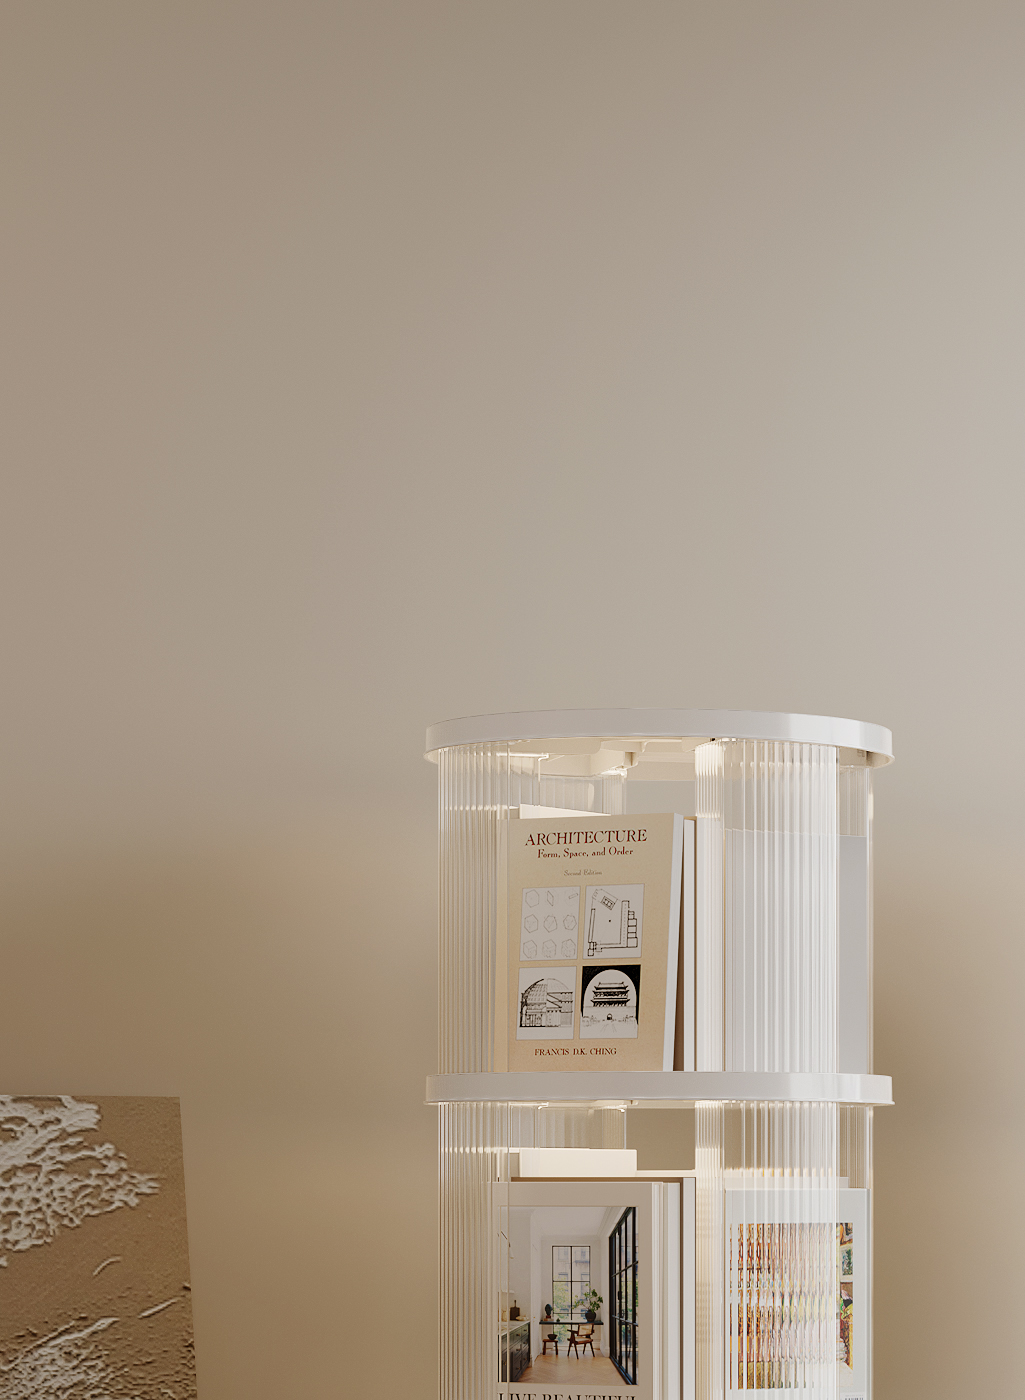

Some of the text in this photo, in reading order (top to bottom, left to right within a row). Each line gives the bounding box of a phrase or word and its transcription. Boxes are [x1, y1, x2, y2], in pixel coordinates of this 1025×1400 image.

[525, 829, 648, 846] ARCHITECTURE
[538, 846, 634, 858] Form, Space, and Order
[534, 1048, 570, 1056] FRANCIS
[590, 1048, 617, 1056] CHING
